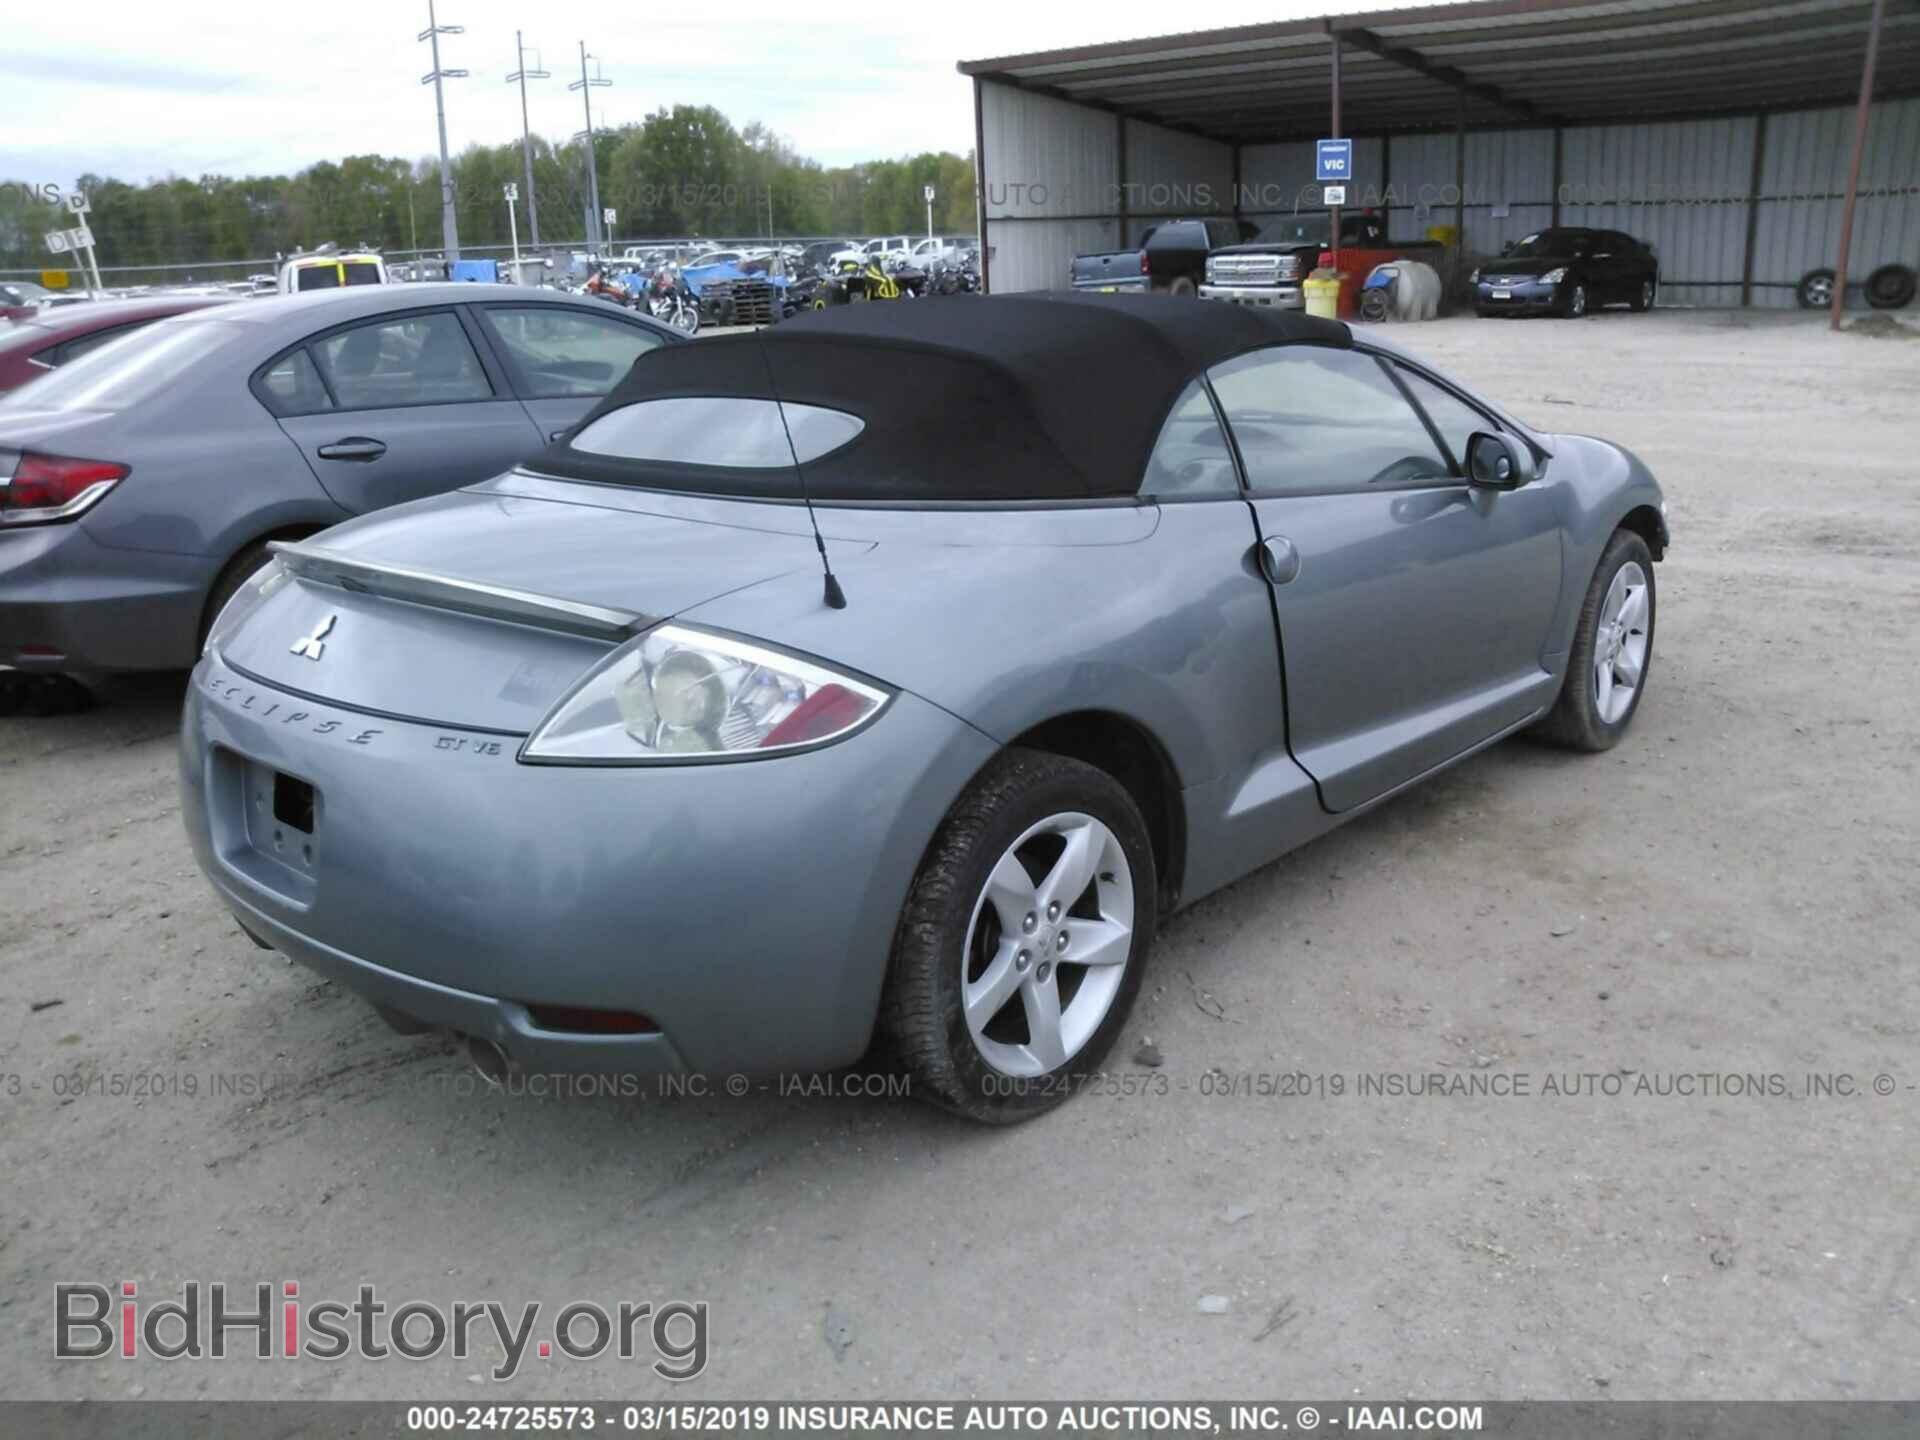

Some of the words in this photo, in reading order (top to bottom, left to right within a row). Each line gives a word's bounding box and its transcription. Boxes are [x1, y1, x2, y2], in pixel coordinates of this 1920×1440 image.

[1323, 159, 1345, 171] VIC
[71, 196, 85, 208] D
[209, 680, 384, 745] ECLIPSE
